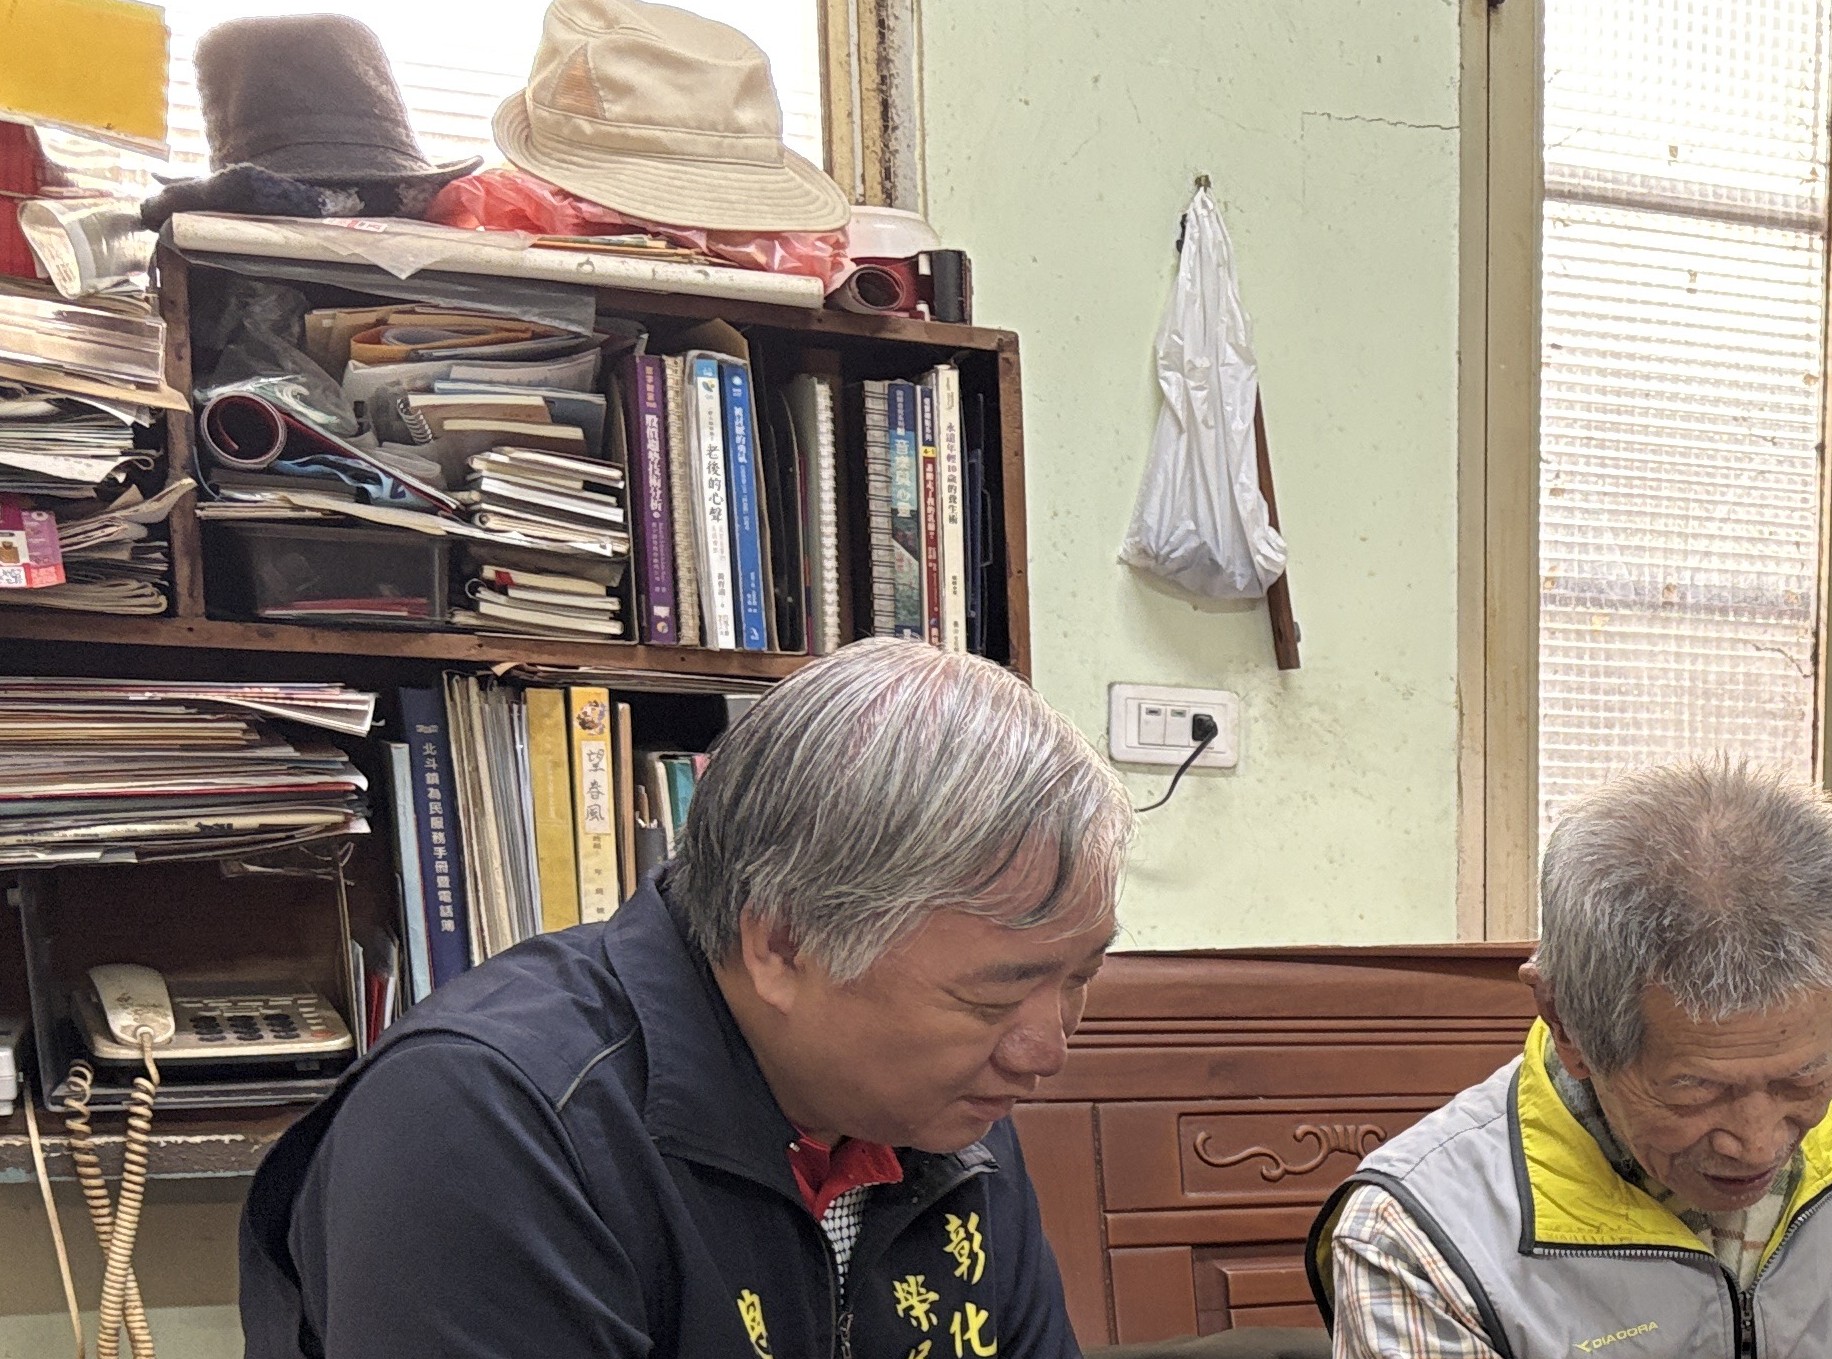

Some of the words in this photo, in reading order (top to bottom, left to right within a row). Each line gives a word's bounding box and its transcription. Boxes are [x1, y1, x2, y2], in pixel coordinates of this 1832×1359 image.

[706, 444, 724, 523] 老後的心聲
[585, 748, 606, 822] 望春風
[1592, 1320, 1659, 1350] DIADORA
